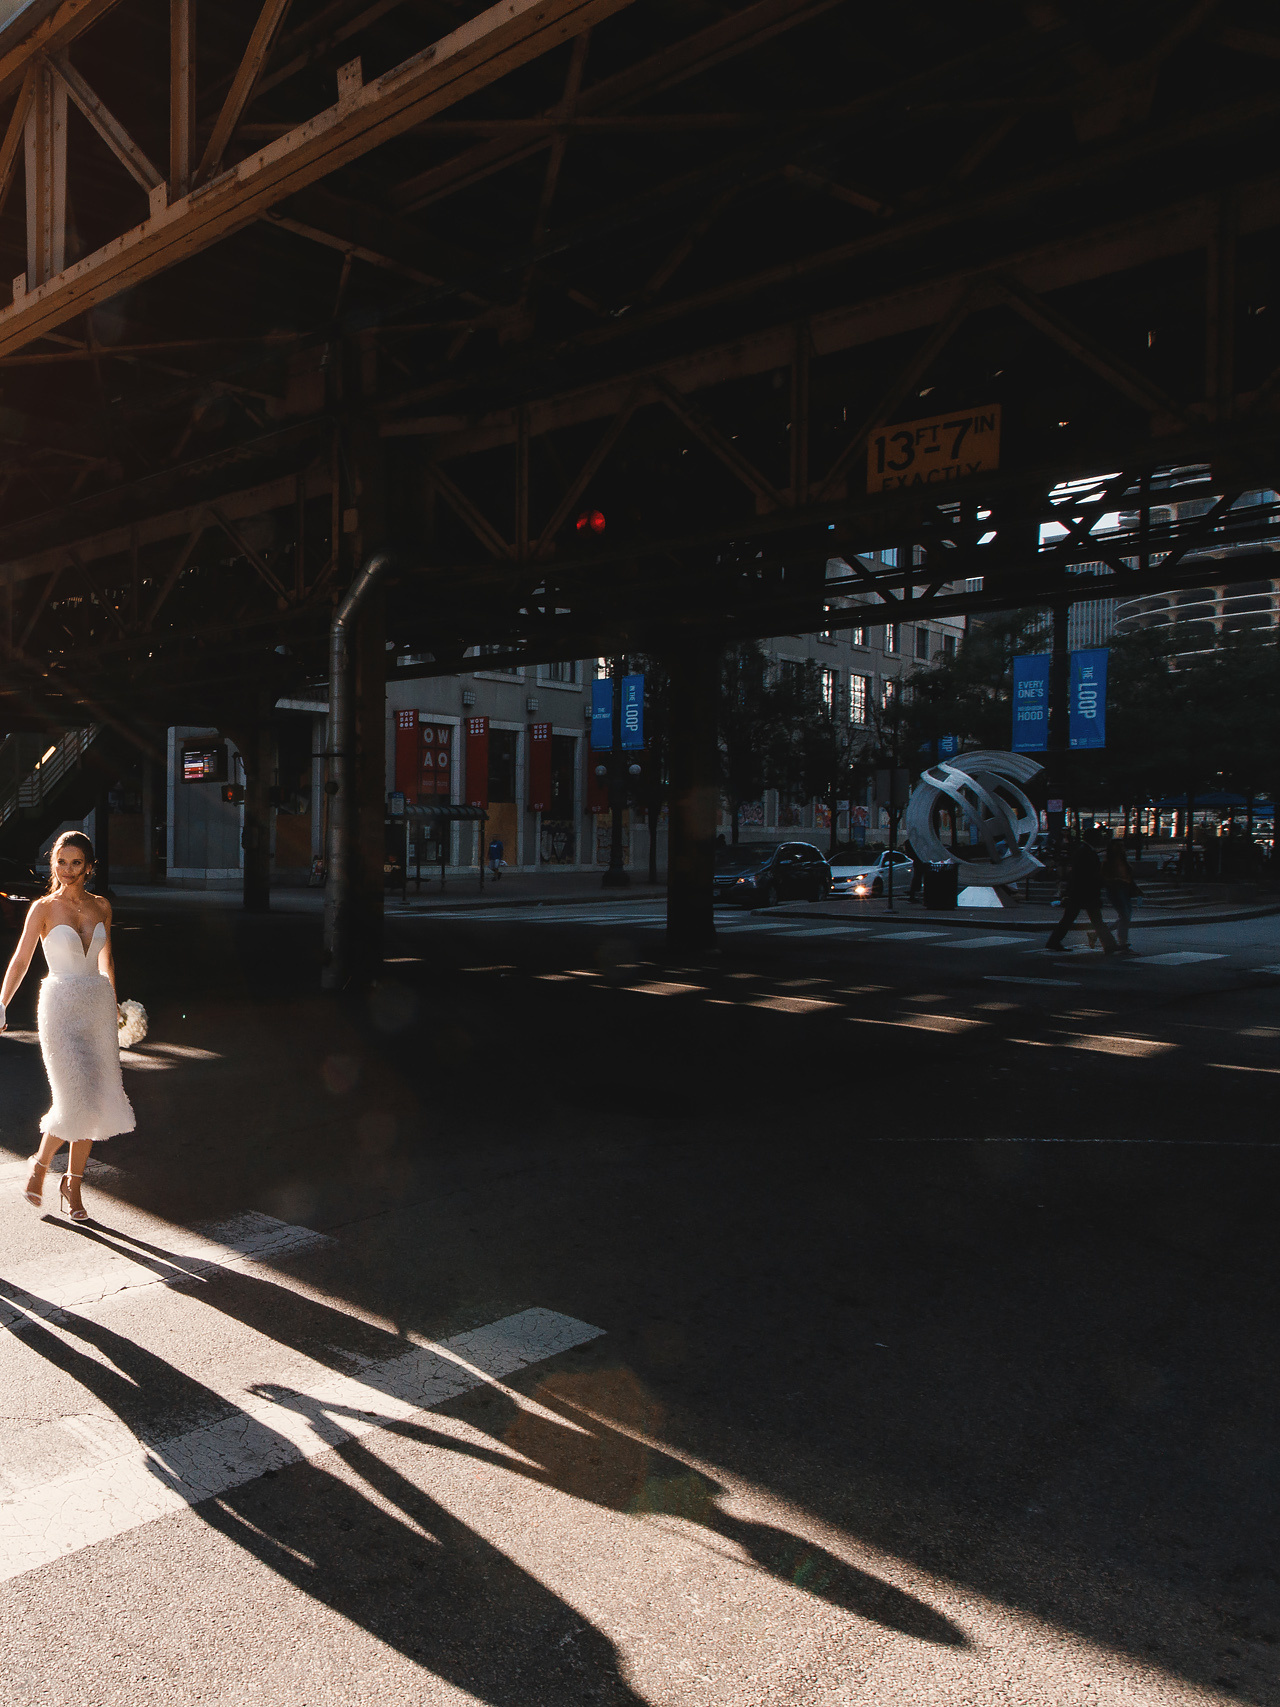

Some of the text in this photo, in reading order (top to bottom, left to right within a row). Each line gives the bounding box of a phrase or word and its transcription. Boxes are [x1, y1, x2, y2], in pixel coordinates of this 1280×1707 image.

[1082, 666, 1095, 680] THE
[1018, 680, 1044, 689] EVERY
[1018, 689, 1044, 698] ONE'S
[1078, 683, 1098, 719] LOOP
[626, 704, 638, 731] LOOP
[1017, 711, 1043, 721] HOOD
